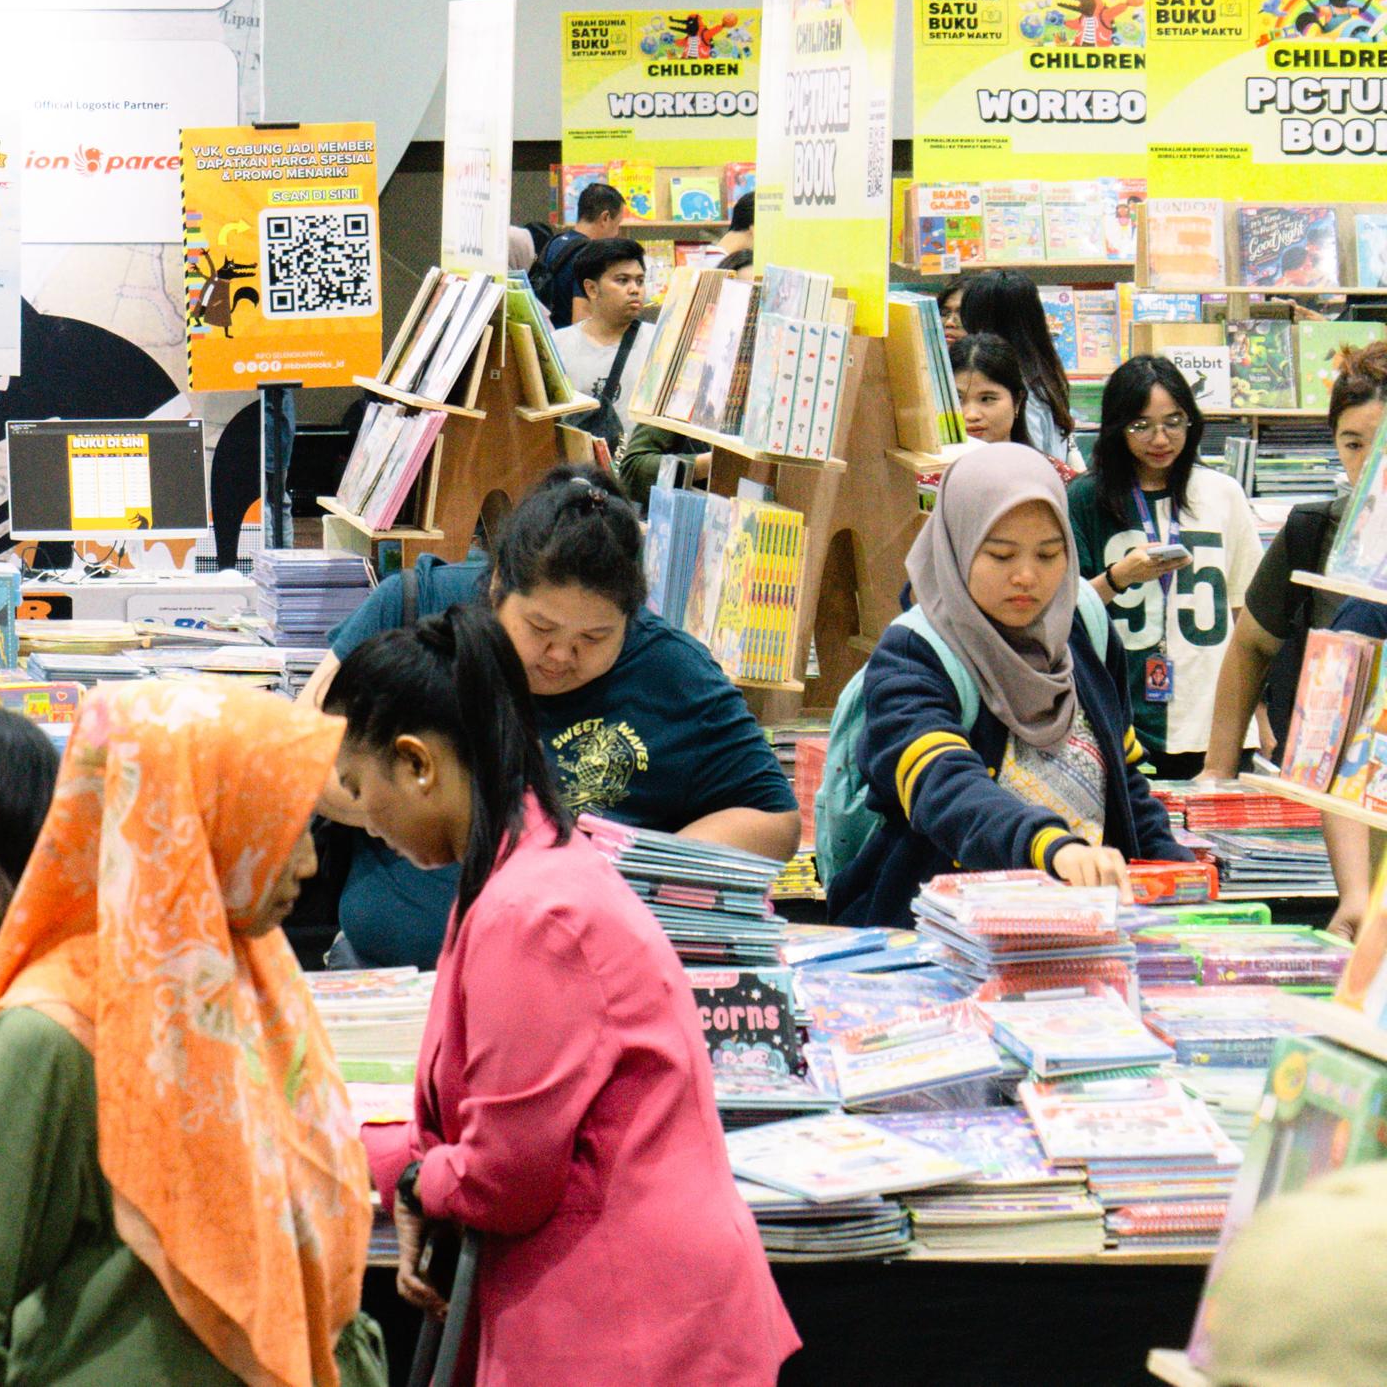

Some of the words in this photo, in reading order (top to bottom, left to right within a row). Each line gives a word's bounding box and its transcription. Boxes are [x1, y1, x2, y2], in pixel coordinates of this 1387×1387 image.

[929, 3, 977, 15] SATU
[929, 18, 978, 29] BUKU
[1156, 10, 1216, 24] BUKU
[572, 28, 609, 38] SATU
[796, 19, 842, 54] CHILDREN
[1157, 28, 1199, 36] SETIAP
[1202, 28, 1242, 36] WAKTU
[572, 39, 609, 49] BUKU
[1030, 53, 1145, 69] CHILDREN
[648, 64, 738, 76] CHILDREN
[124, 101, 168, 110] Partner:
[608, 91, 759, 118] WORKBOO
[785, 67, 851, 136] PICTURE
[977, 89, 1146, 123] WORKBO
[191, 146, 222, 157] YUK,
[226, 144, 282, 155] GABUNG
[285, 143, 315, 154] JADI
[317, 141, 373, 153] MEMBER
[26, 149, 69, 170] ion
[197, 157, 268, 170] DAPATKAN
[271, 156, 317, 167] HARGA
[320, 154, 372, 165] SPESIAL
[222, 172, 230, 181] &
[234, 169, 282, 180] PROMO
[286, 167, 348, 178] MENARIK!
[793, 138, 836, 206] BOOK
[273, 190, 309, 202] SCAN
[313, 190, 325, 200] DI
[932, 190, 967, 199] BRAIN
[1174, 356, 1222, 368] Rabbit
[72, 438, 105, 448] BUKU
[107, 438, 120, 448] DI
[121, 438, 143, 448] SINI
[1104, 529, 1228, 651] 95
[552, 718, 604, 750] SWEET
[618, 721, 649, 772] WAVES
[698, 1005, 780, 1031] corns
